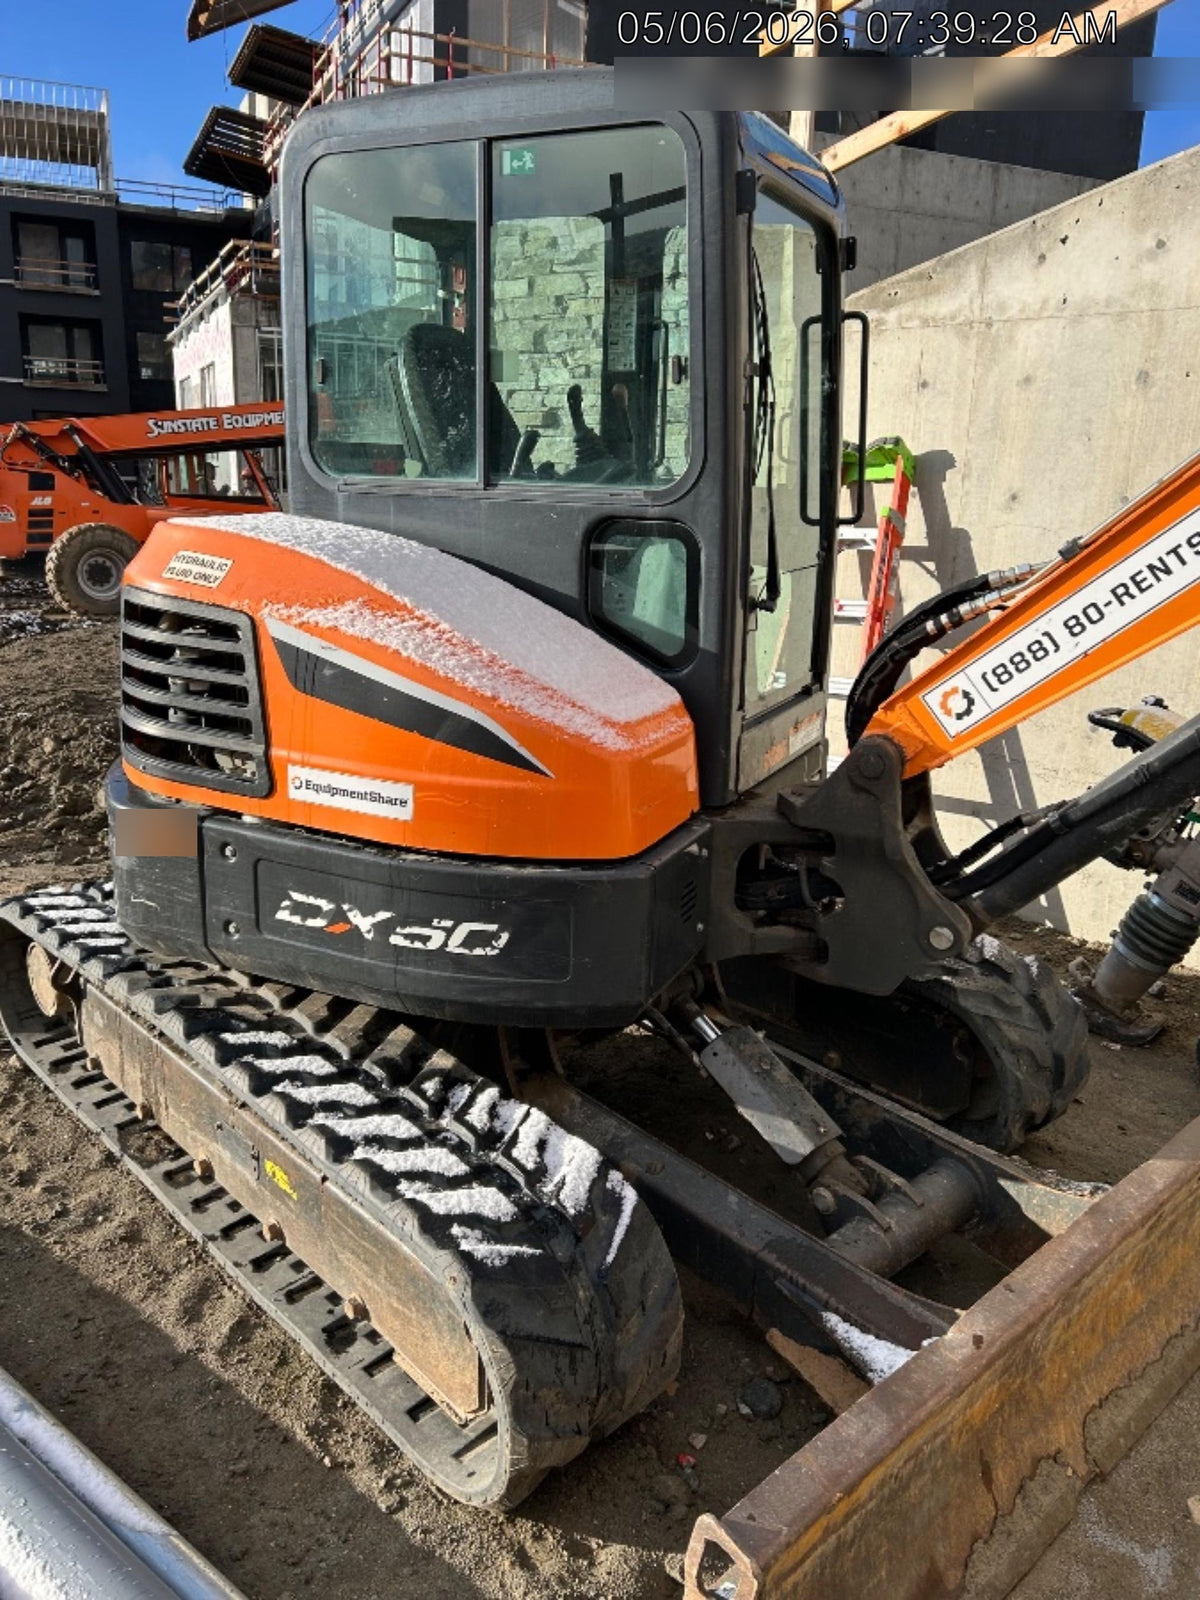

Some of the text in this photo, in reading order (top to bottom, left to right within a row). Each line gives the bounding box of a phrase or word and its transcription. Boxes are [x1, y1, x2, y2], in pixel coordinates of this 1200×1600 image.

[146, 411, 285, 438] SUNSTATE EQUIPME
[165, 566, 221, 584] FLUID ONLY
[173, 554, 229, 573] HYDRAULIC
[981, 630, 1060, 692] (888)
[305, 779, 408, 807] EquipmentShare
